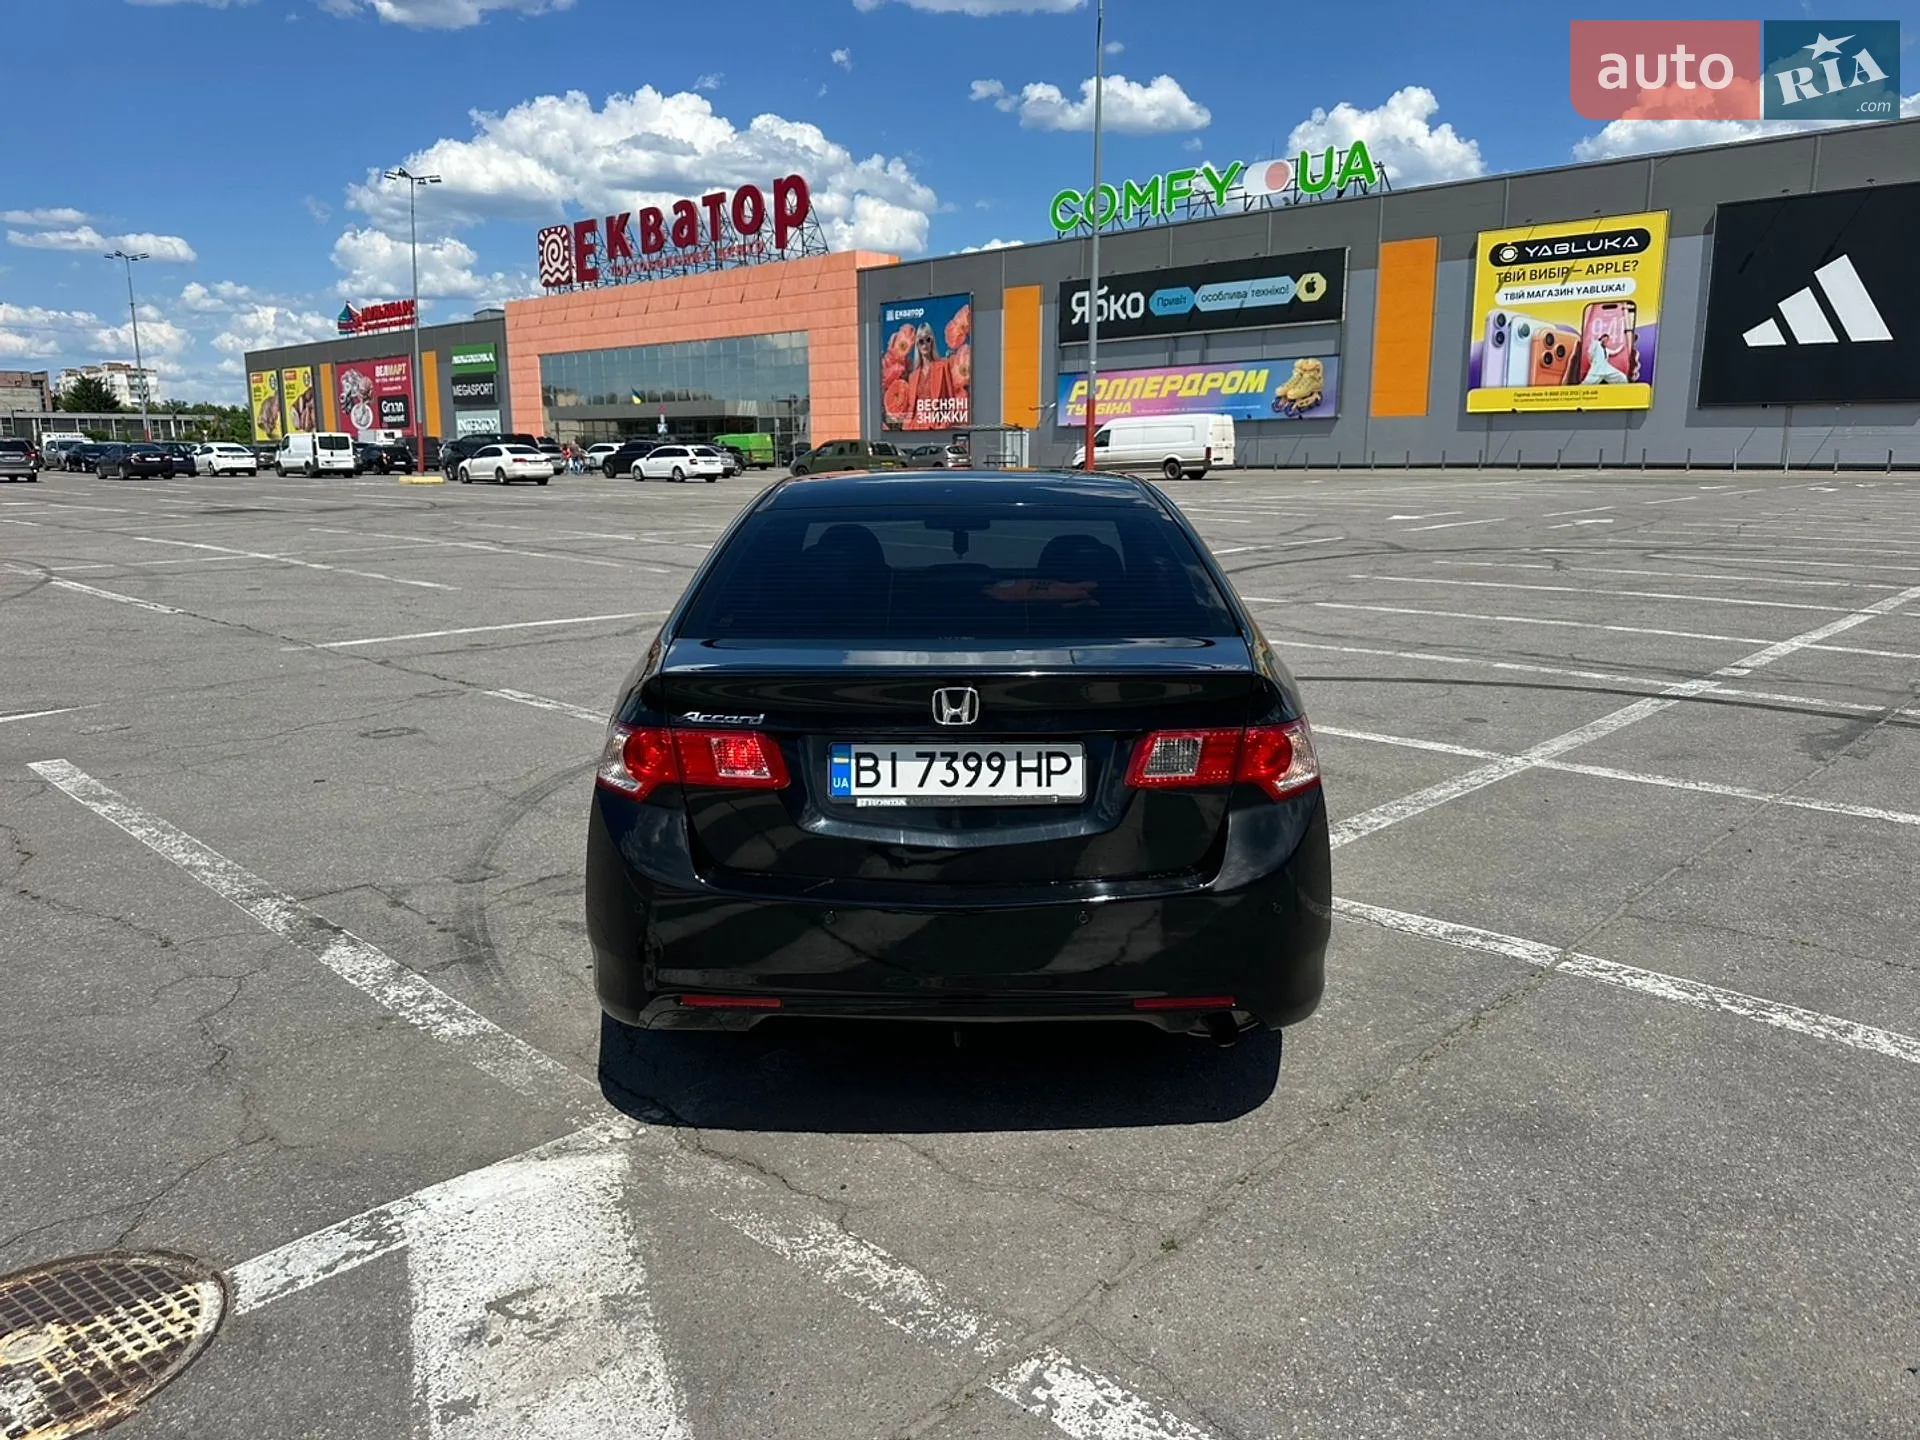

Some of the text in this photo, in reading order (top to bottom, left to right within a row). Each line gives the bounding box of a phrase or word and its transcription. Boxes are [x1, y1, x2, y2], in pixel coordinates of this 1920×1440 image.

[1049, 139, 1378, 232] COMFY UA
[1525, 235, 1639, 257] YABLUKA
[1496, 268, 1526, 283] ТВІЙ
[1529, 267, 1570, 281] ВИБІР
[1585, 260, 1639, 275] APPLE?
[1504, 283, 1626, 301] ТВІЙ МАГАЗИН YABLUKA!
[1071, 285, 1145, 325] Ябко
[452, 383, 493, 397] MEGASPORT
[1069, 368, 1270, 402] РОЛЛЕРДРОМ
[916, 397, 968, 411] ВЕСНЯНІ
[1065, 402, 1132, 416] ТУБІНА
[916, 410, 968, 424] ЗНИЖКИ
[682, 711, 765, 725] Accord
[855, 751, 1072, 788] BI 7399 HP
[833, 777, 849, 788] UA
